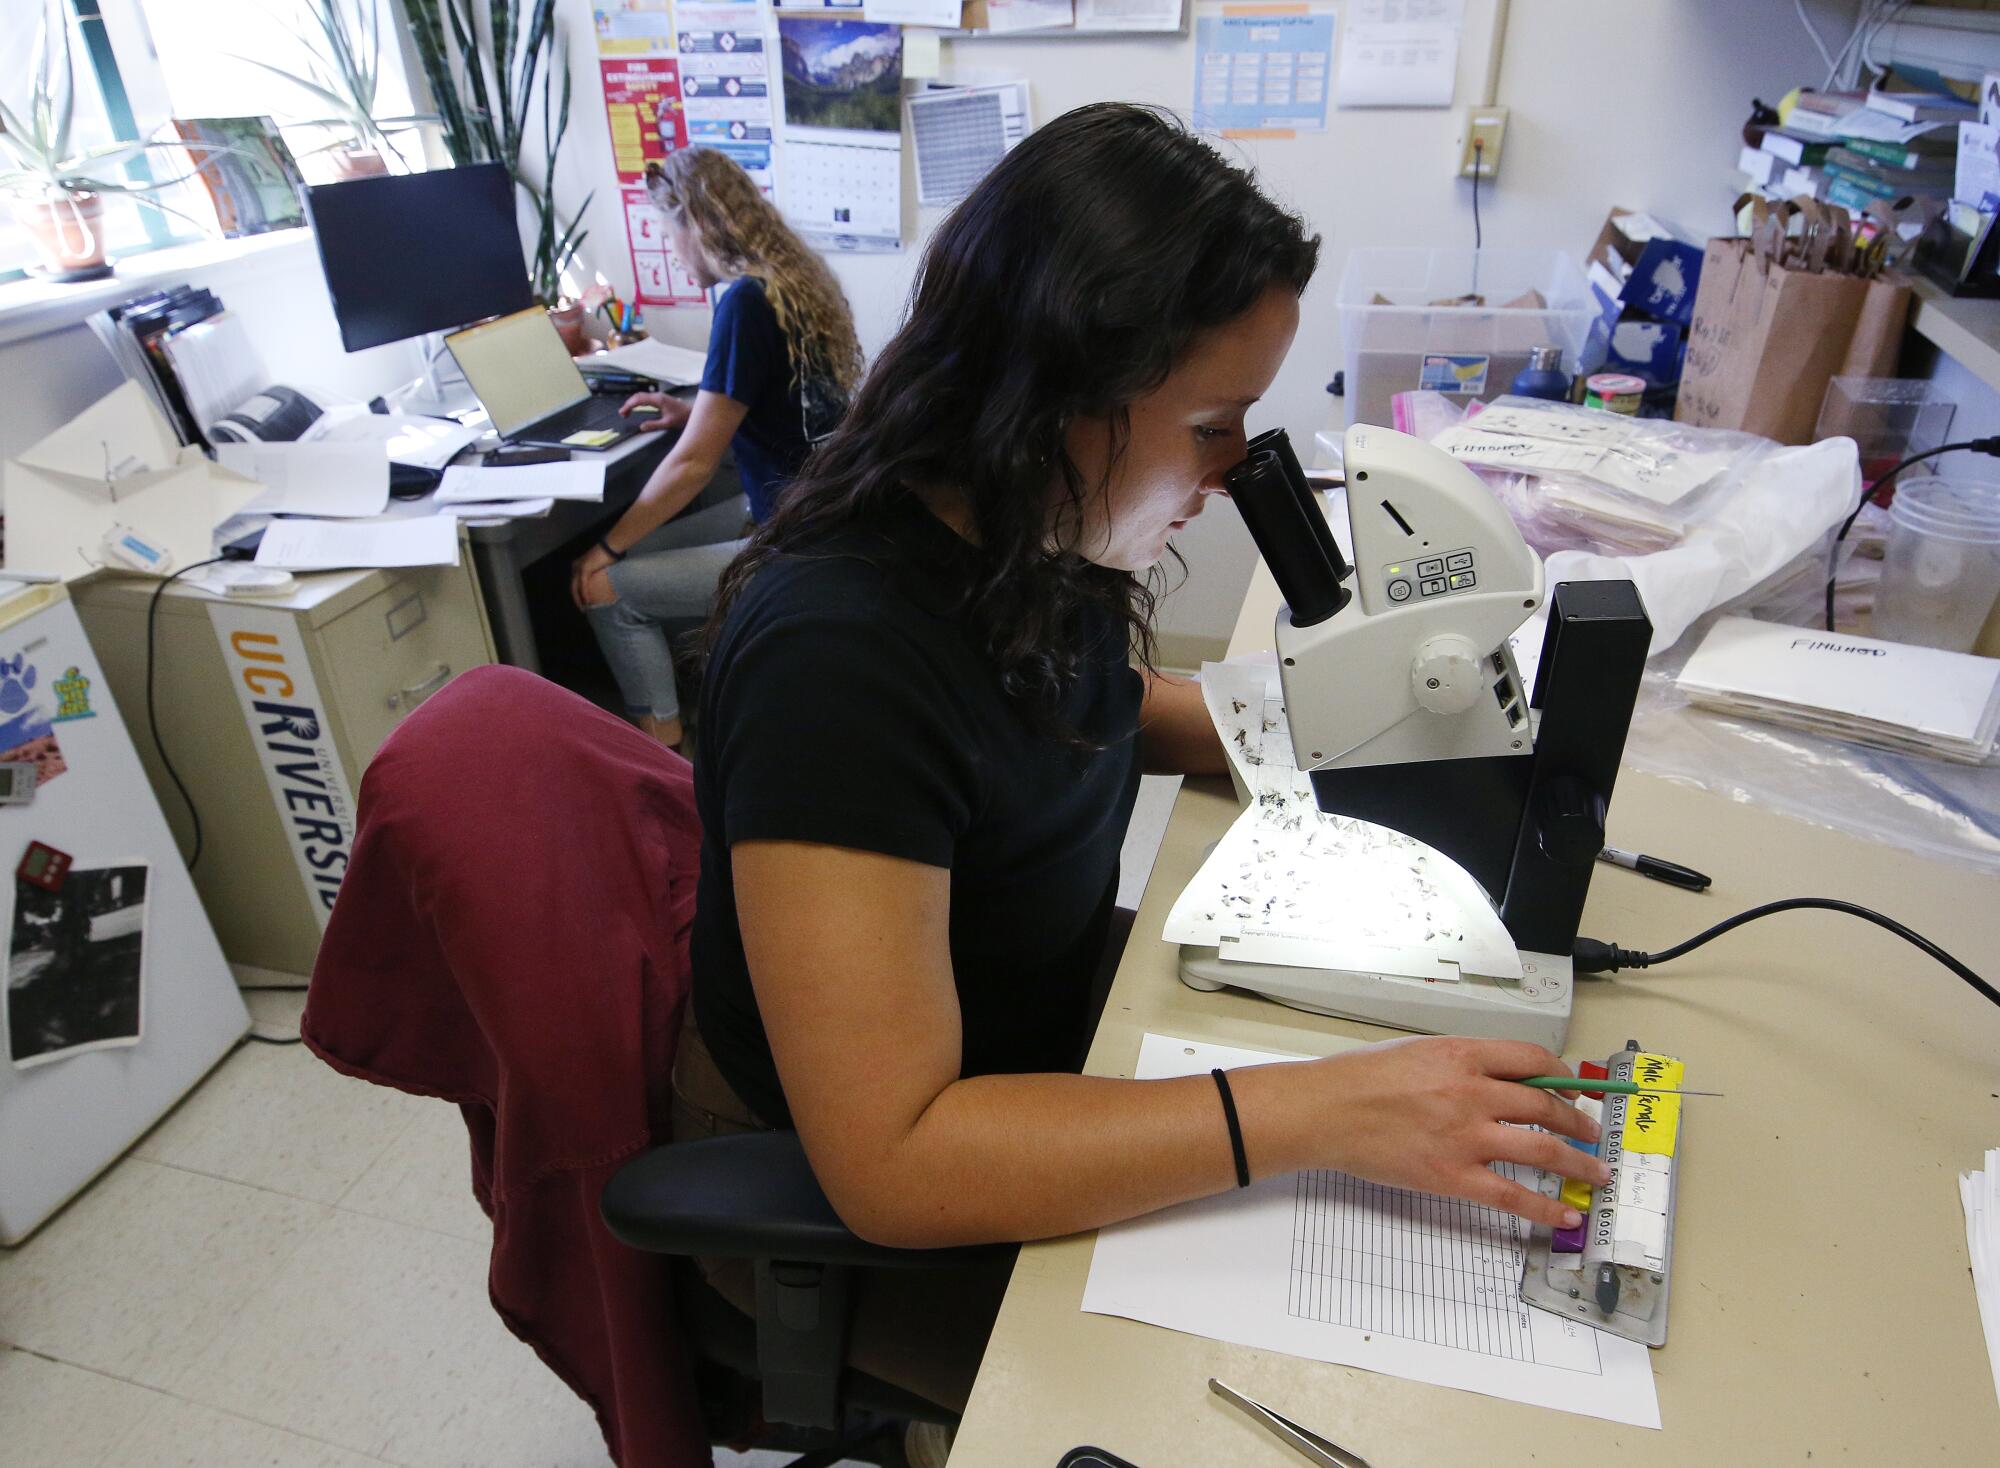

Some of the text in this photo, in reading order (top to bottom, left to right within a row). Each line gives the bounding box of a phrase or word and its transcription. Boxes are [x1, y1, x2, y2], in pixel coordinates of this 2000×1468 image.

[230, 630, 294, 698] UC
[1635, 1056, 1664, 1083] Male
[1634, 1093, 1661, 1133] Female
